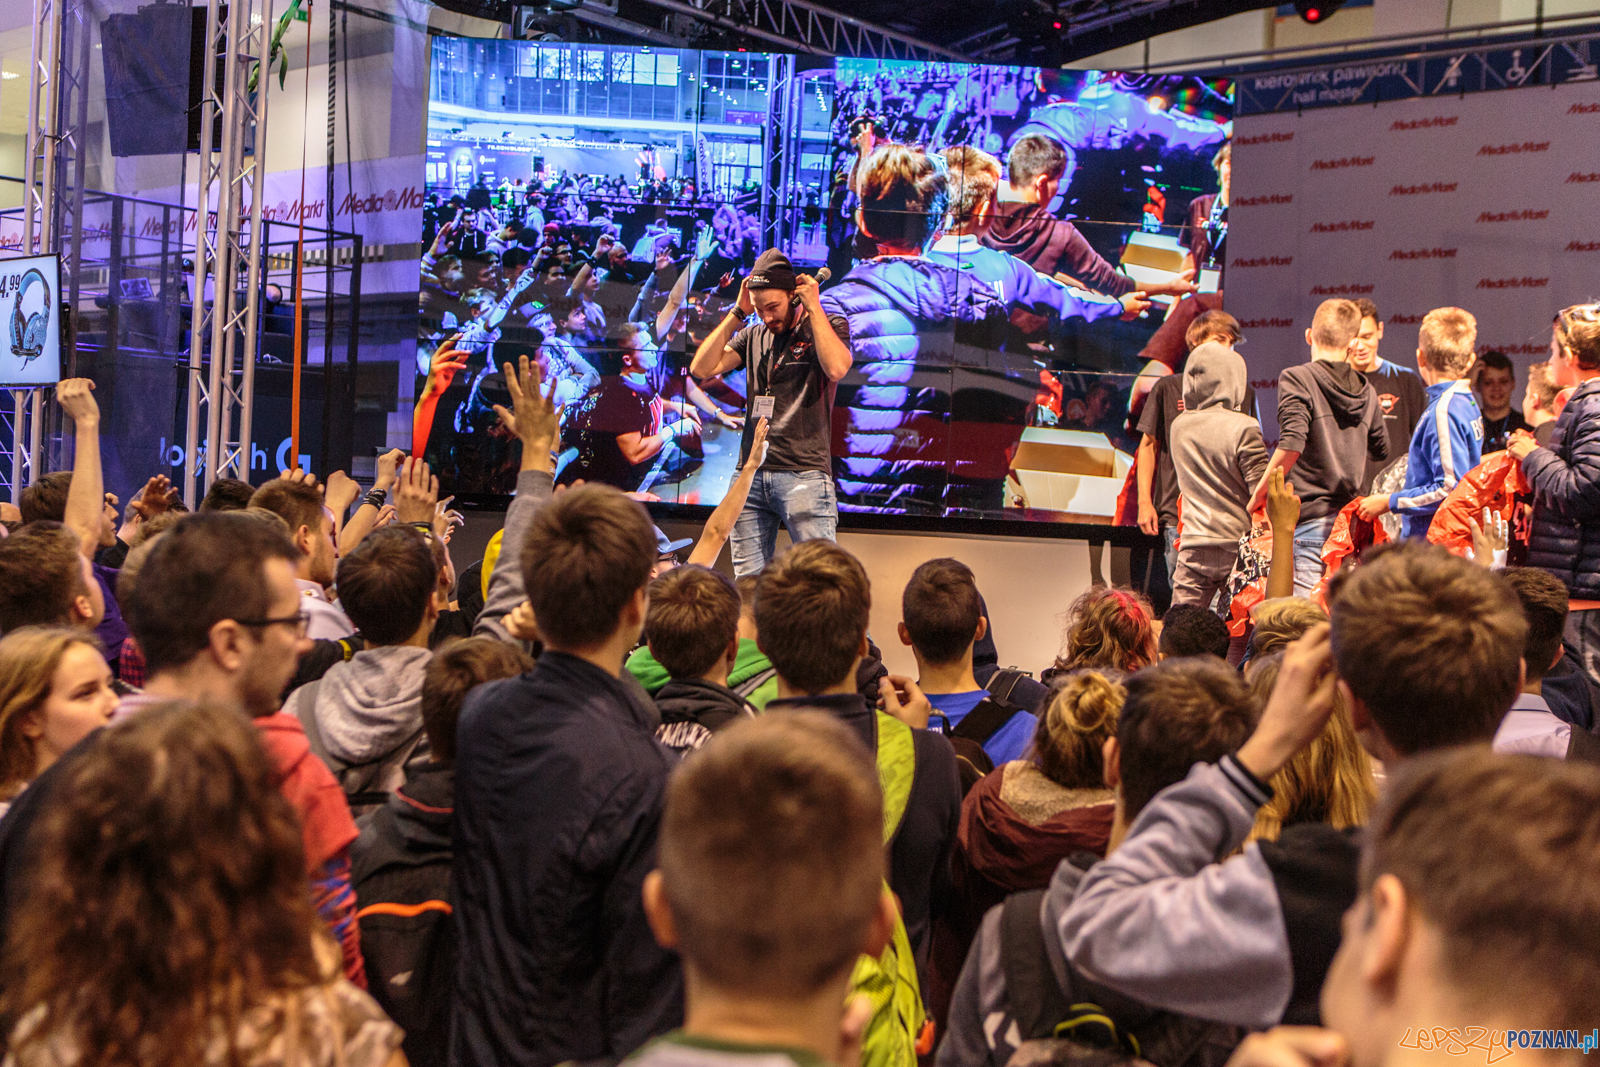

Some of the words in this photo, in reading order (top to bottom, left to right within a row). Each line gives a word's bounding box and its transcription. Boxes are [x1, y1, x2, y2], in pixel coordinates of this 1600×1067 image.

[241, 202, 276, 225] Mdia
[286, 199, 326, 221] Markt
[336, 192, 384, 217] Media
[140, 216, 177, 237] Mea
